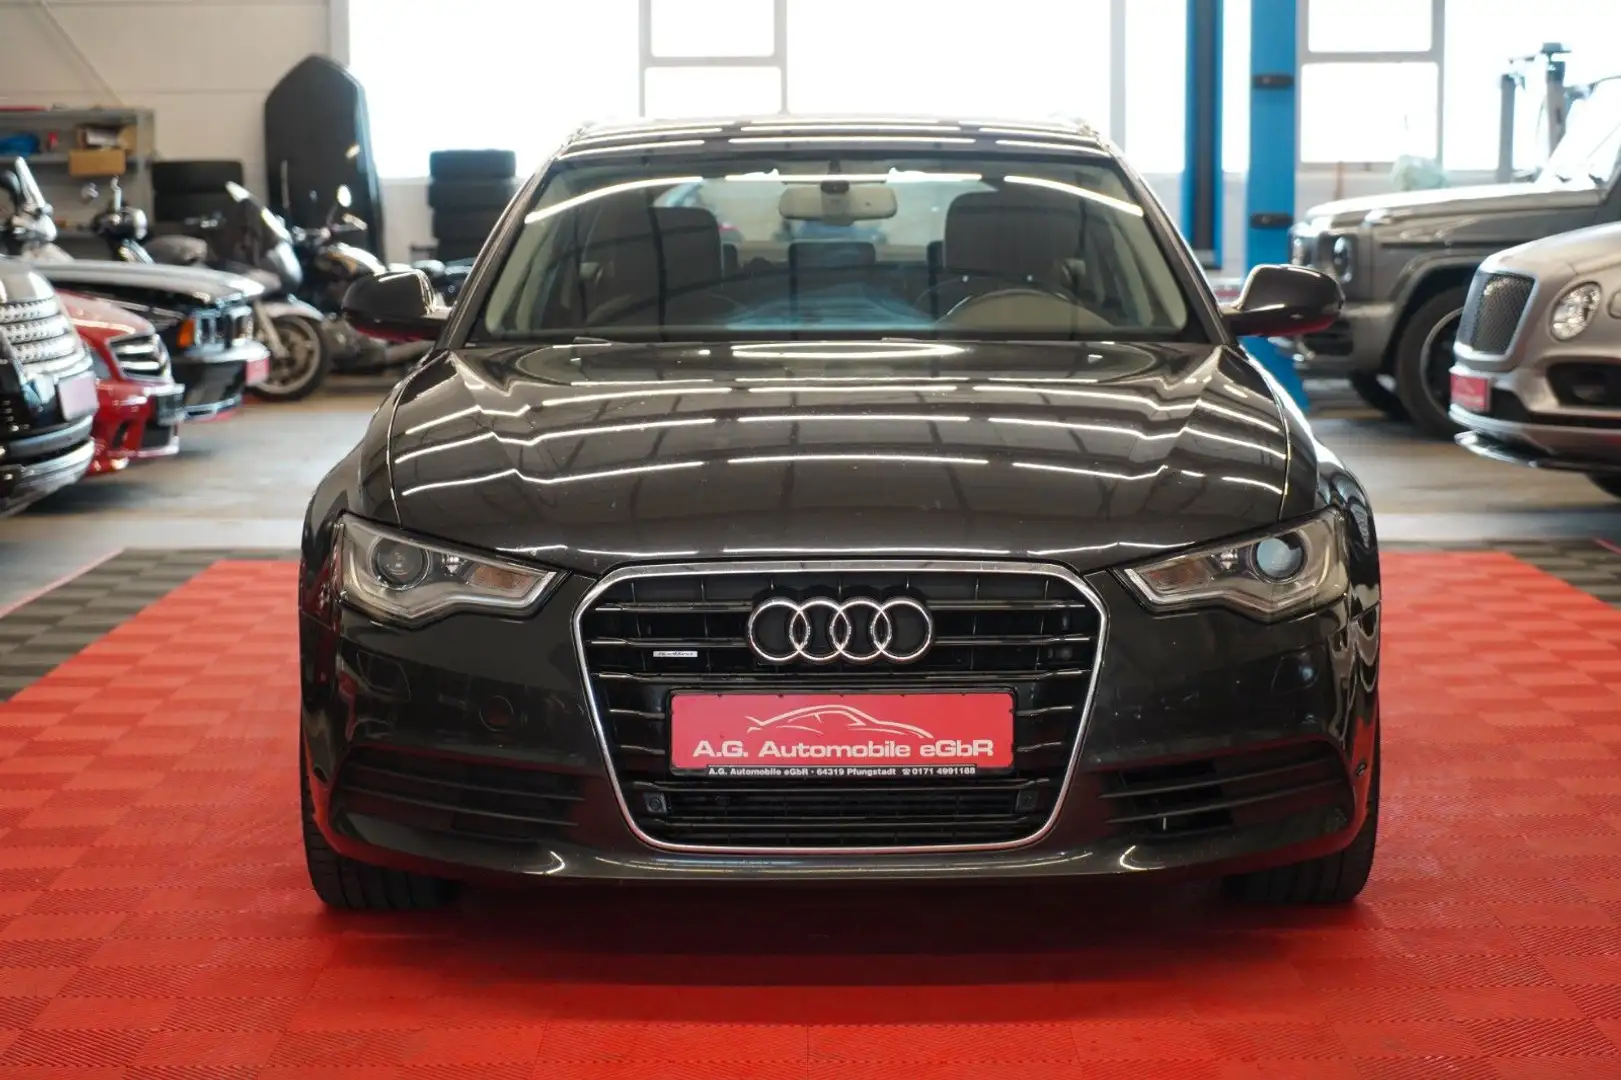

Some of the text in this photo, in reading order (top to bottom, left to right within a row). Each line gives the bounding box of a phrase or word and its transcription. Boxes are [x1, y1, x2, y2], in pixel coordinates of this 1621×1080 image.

[692, 739, 994, 759] A.G. Automobile eGbR
[708, 767, 728, 776] A.G.
[730, 767, 782, 776] Automobile
[783, 767, 809, 776] eGbR
[816, 767, 845, 776] 64319
[846, 767, 897, 777] Pfungstadt
[911, 767, 934, 776] 0171
